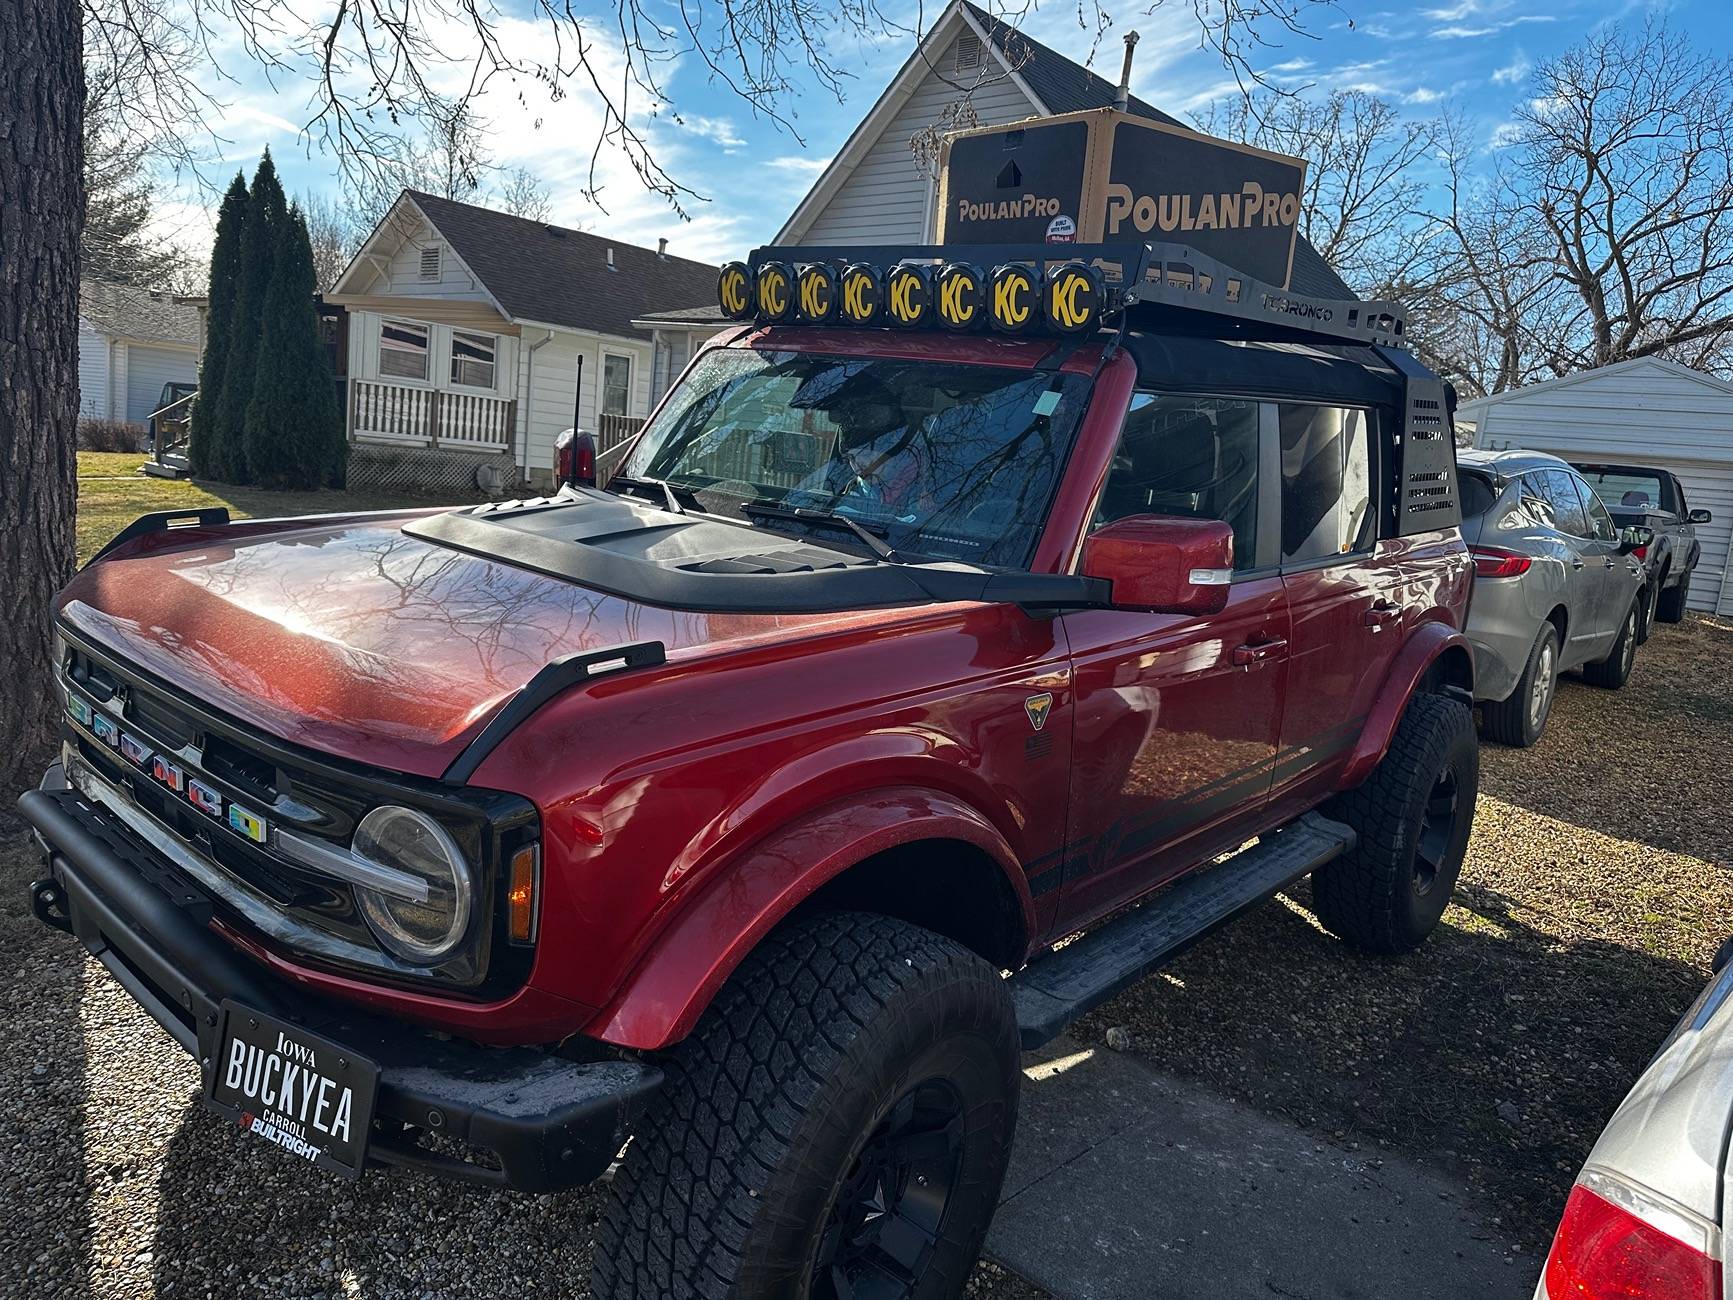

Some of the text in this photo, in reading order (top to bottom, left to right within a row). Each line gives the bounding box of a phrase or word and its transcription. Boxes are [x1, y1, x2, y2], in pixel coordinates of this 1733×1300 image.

[722, 270, 745, 313] KC
[760, 271, 785, 315] KC
[801, 272, 827, 317] KC
[844, 273, 873, 320] KC
[891, 273, 921, 322] KC
[941, 273, 974, 324] KC
[994, 273, 1029, 326] KC
[1052, 273, 1090, 327] KC
[69, 694, 267, 843] BRONCO
[225, 1037, 352, 1143] BUCKYEA
[250, 1117, 321, 1162] BUILTRIGHT
[263, 1108, 306, 1141] CARROLL
